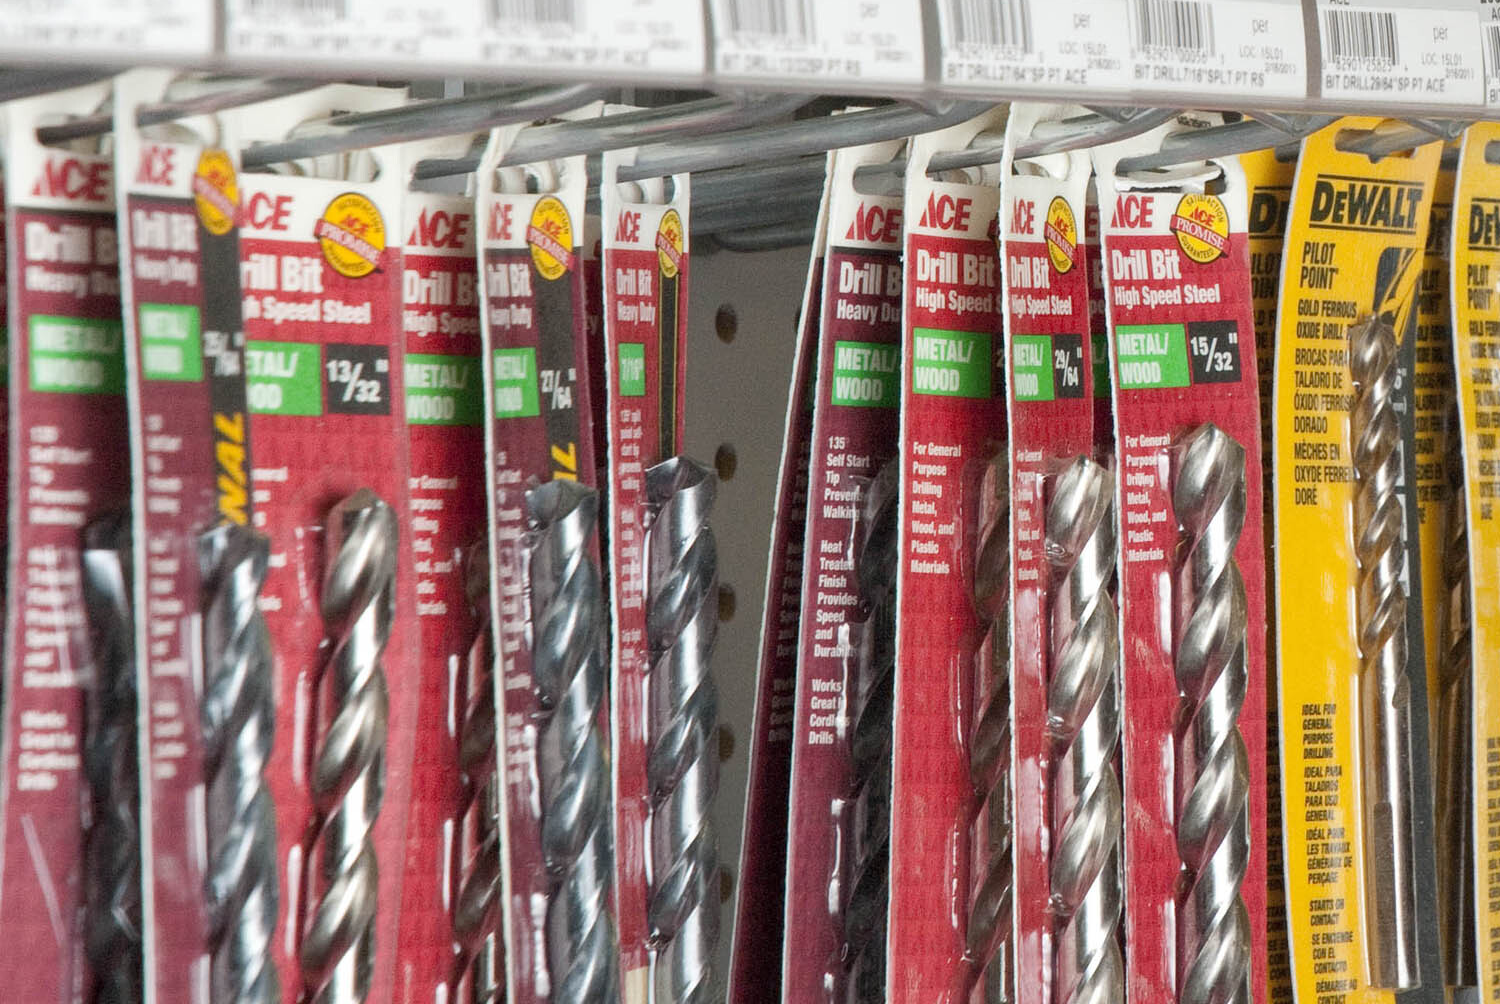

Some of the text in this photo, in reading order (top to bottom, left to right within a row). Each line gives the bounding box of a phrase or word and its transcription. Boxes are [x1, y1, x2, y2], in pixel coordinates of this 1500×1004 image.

[1326, 76, 1445, 92] BIT ACE
[919, 190, 972, 231] ACE
[1111, 195, 1154, 229] ACE
[1309, 179, 1424, 229] DEWALT
[1011, 196, 1035, 235] ACE
[1189, 206, 1214, 227] ACE
[615, 211, 642, 244] ACE
[1175, 217, 1224, 248] PROMISE
[1302, 241, 1336, 265] PILOT
[916, 250, 995, 287] Drill Bit
[1010, 255, 1050, 289] Drill Bit
[1112, 248, 1182, 281] Drill Bit
[281, 255, 324, 294] Bit
[616, 268, 653, 297] Drill Bit
[839, 260, 882, 295] Drill
[1300, 267, 1336, 290] POINT
[403, 270, 450, 306] Drill
[1114, 284, 1221, 310] High Speed Steel
[916, 287, 993, 315] High Speed
[1298, 299, 1357, 318] GOLD FERROUS
[323, 300, 372, 324] Steel
[837, 299, 877, 325] Heavy
[1297, 322, 1343, 339] OXIDE DRILL
[916, 336, 974, 363] METAL/
[1119, 332, 1169, 356] METAL/
[1295, 348, 1326, 366] BROCAS
[916, 367, 960, 391] WOOD
[1121, 361, 1161, 385] WOOD
[1295, 370, 1342, 388] TALADRO DE
[836, 376, 883, 401] WOOD
[1294, 416, 1328, 433] DORADO
[913, 441, 962, 458] For General
[1125, 433, 1170, 448] For General
[827, 453, 870, 468] Self Start
[1330, 444, 1340, 460] EN
[913, 461, 947, 477] Purpose
[1295, 465, 1321, 483] OXYDE
[826, 471, 840, 486] Tip
[1126, 473, 1154, 488] Drilling
[912, 480, 942, 498] Drilling
[1295, 484, 1317, 505] DORÉ
[912, 499, 937, 517] Metal,
[1127, 493, 1151, 506] Metal,
[1151, 509, 1166, 522] and
[911, 519, 954, 536] Wood, and
[1128, 531, 1154, 543] Plastic
[821, 540, 842, 553] Heat
[911, 540, 939, 555] Plastic
[911, 559, 949, 575] Materials
[819, 575, 846, 589] Finish
[816, 610, 845, 625] Speed
[815, 627, 833, 640] and
[1302, 718, 1332, 731] GENERAL
[1303, 733, 1334, 746] PURPOSE
[1304, 766, 1323, 779] IDEAL
[1305, 796, 1322, 808] PARA
[1307, 843, 1319, 855] LES
[1310, 899, 1333, 912] STARTS
[1313, 948, 1326, 960] CON
